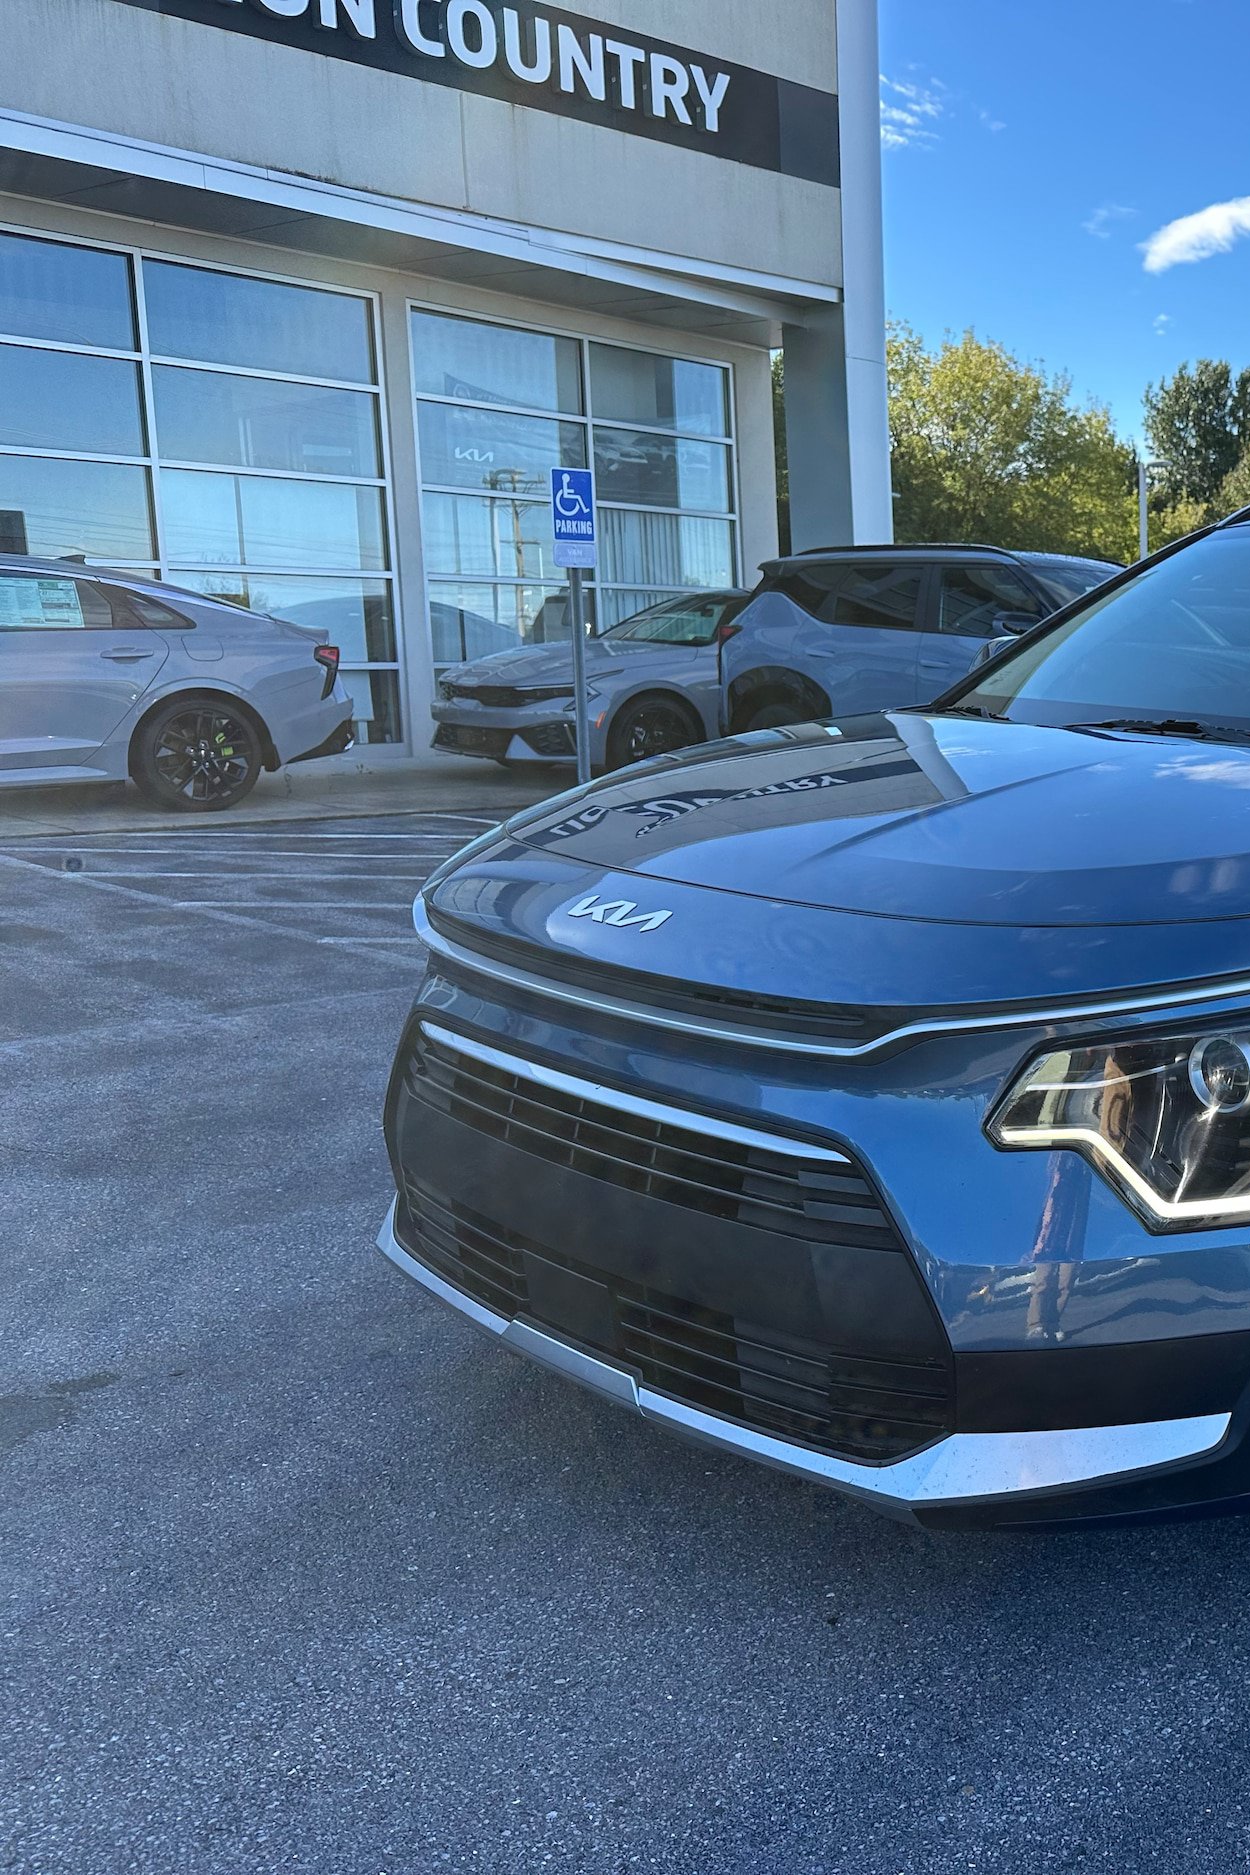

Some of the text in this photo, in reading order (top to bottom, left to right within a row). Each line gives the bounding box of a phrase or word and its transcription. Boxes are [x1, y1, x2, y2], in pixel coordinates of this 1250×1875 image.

[401, 0, 730, 131] COUNTRY
[555, 519, 593, 535] PARKING
[567, 895, 673, 933] KIA
